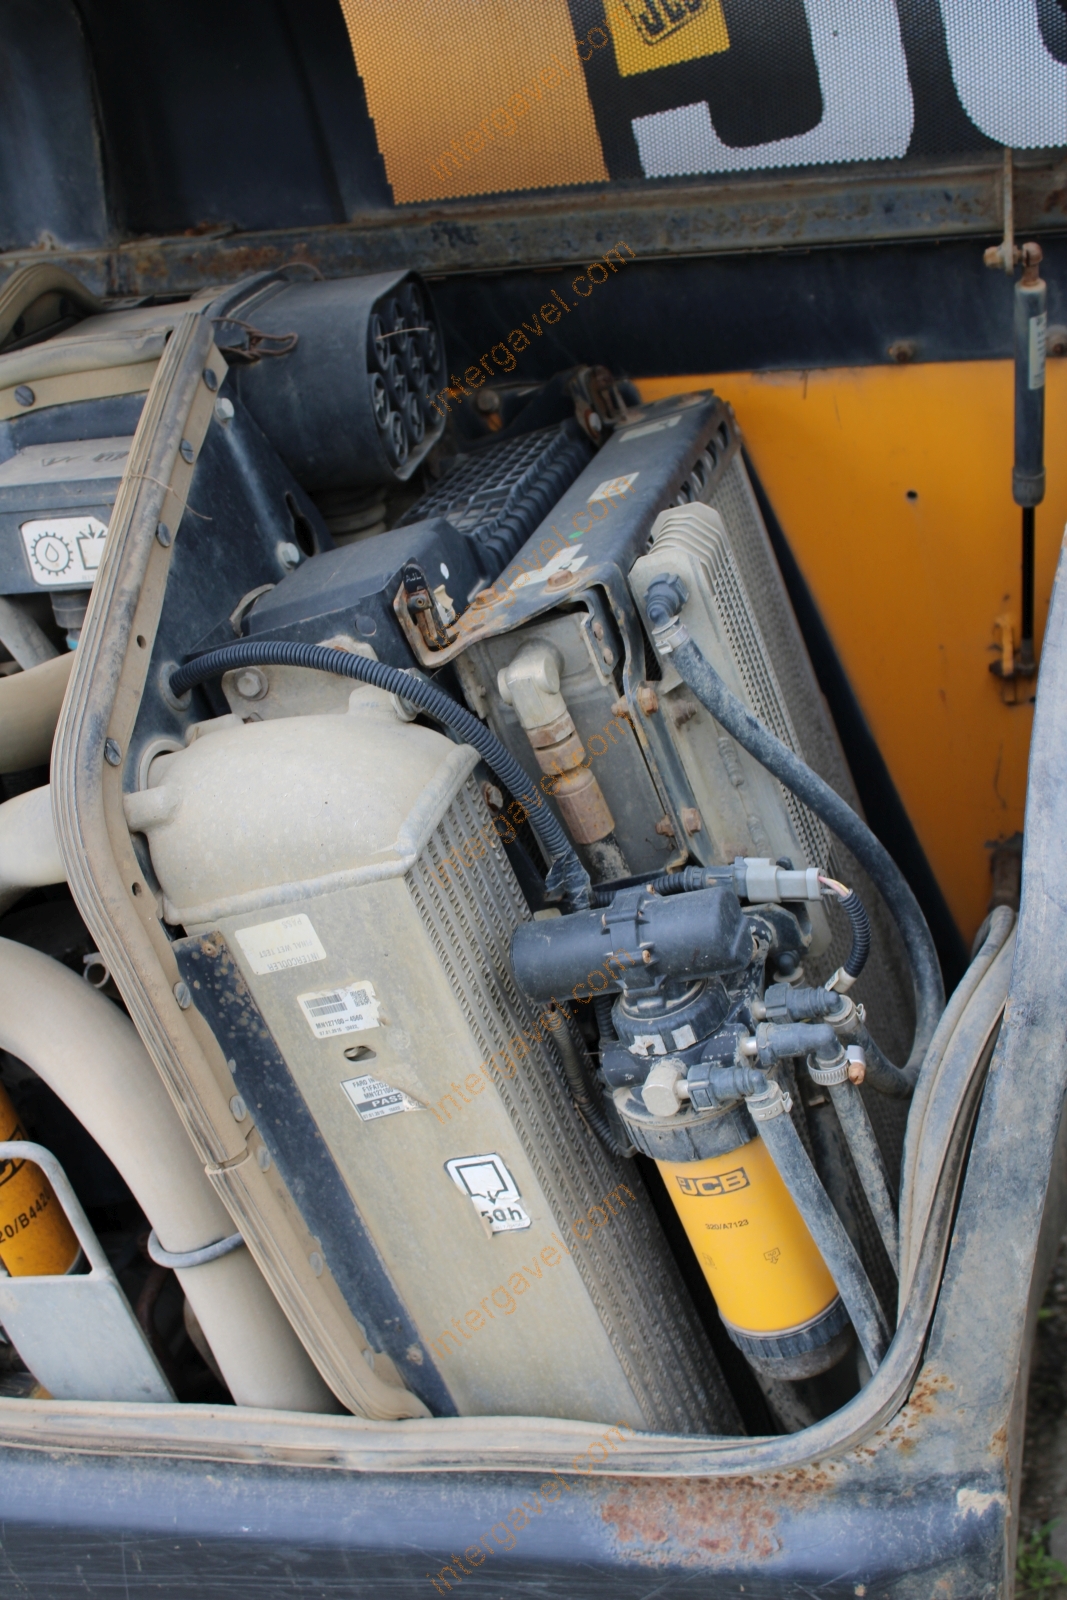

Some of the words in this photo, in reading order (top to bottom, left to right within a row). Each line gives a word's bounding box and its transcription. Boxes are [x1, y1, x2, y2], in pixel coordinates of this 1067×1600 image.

[282, 918, 302, 929] PASS
[278, 944, 292, 954] WET
[295, 939, 313, 948] FINAL
[260, 949, 276, 959] TEST
[267, 952, 319, 971] INTERCOOLER
[677, 1169, 749, 1196] JCB
[705, 1219, 749, 1230] 320/A7123
